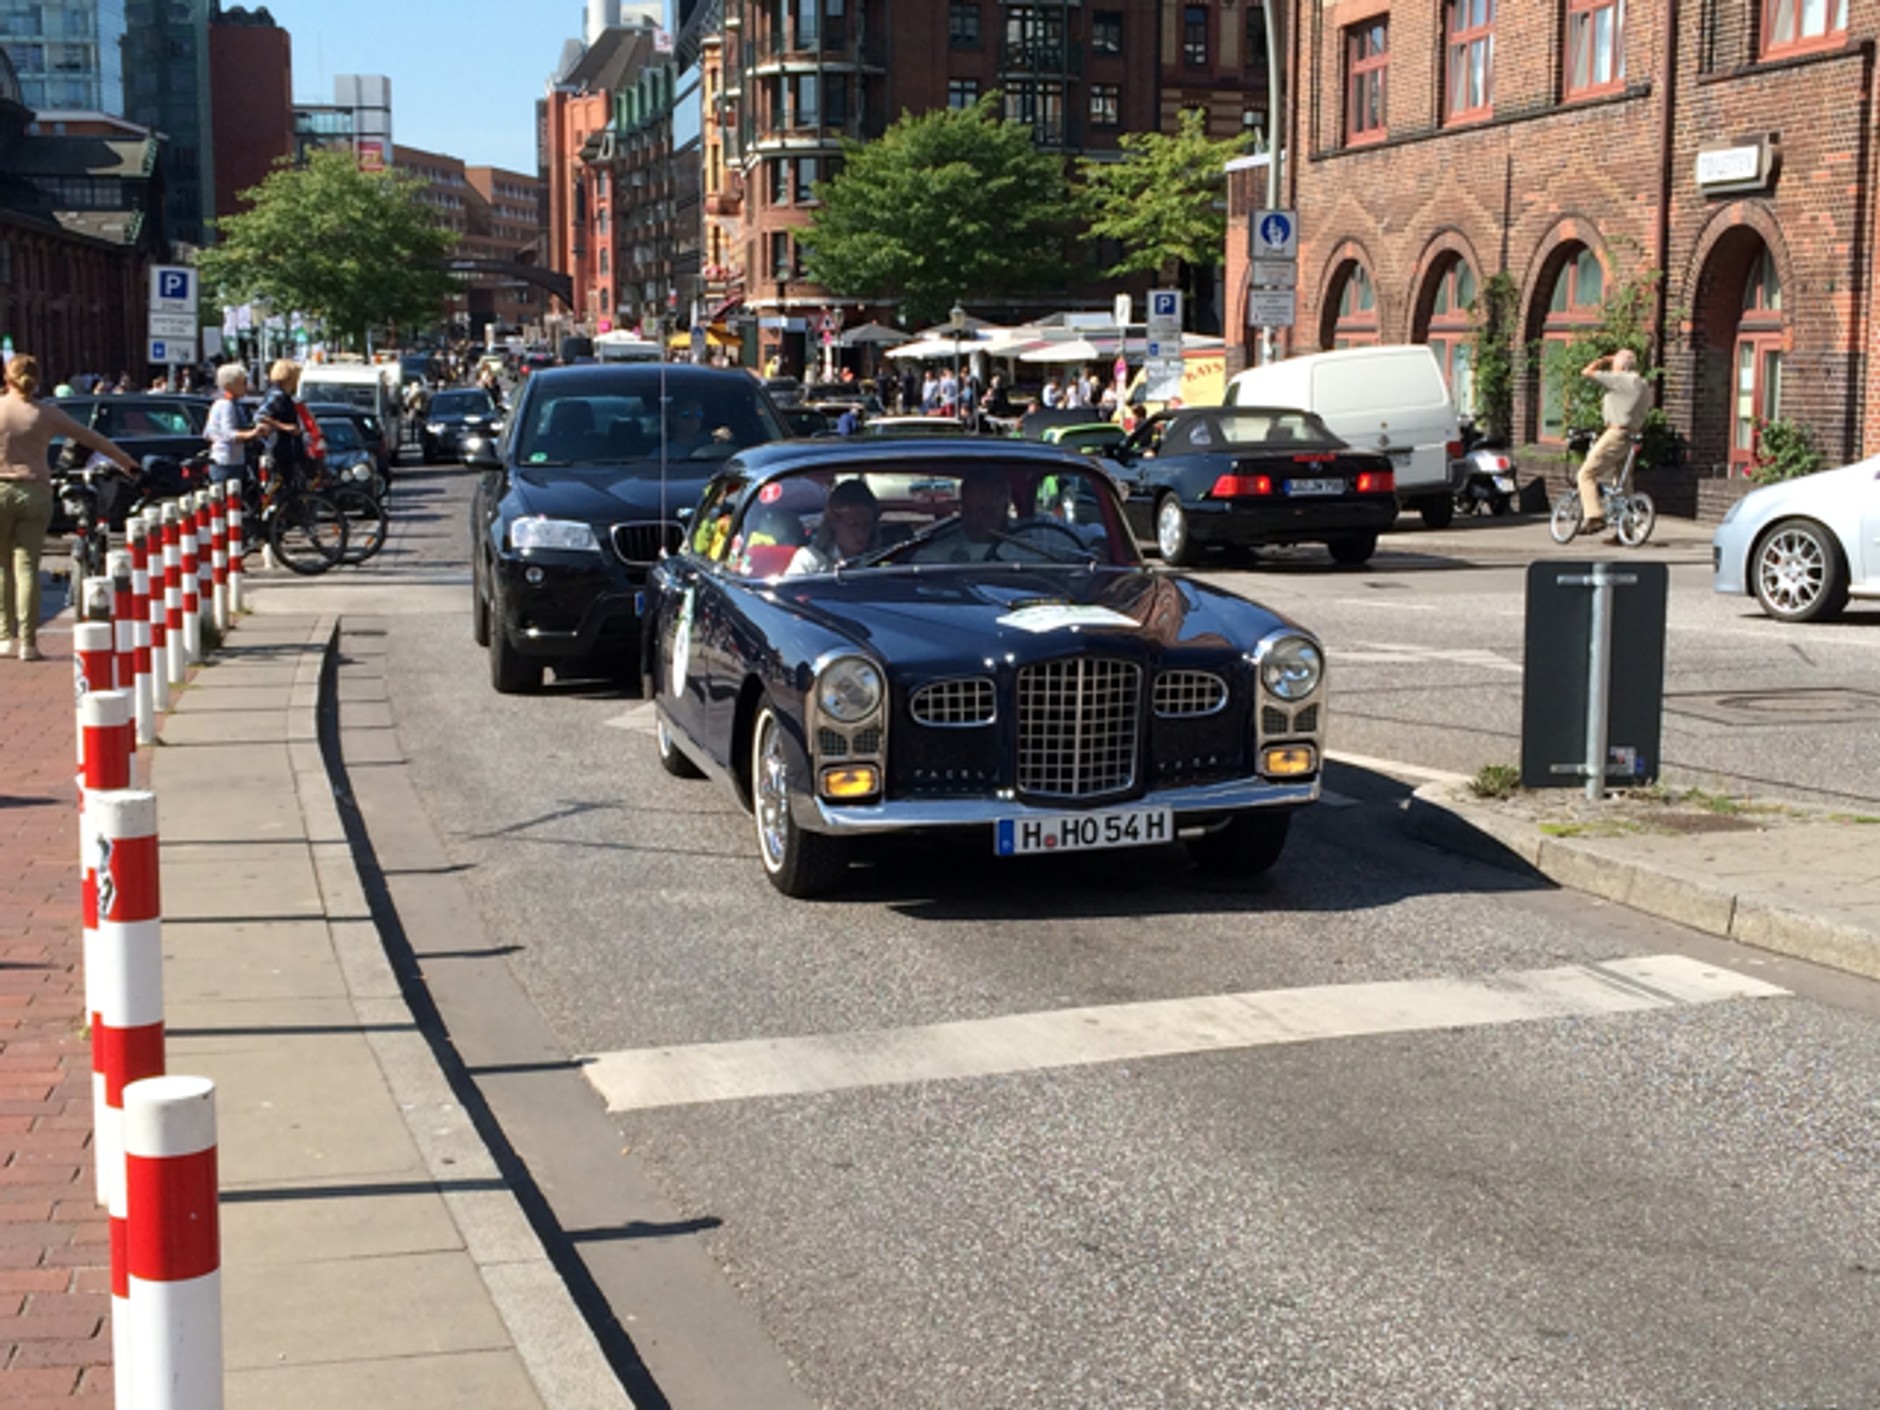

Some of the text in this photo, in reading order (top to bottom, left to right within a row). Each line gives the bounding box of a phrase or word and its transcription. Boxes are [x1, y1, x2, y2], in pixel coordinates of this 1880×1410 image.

[165, 273, 182, 295] P
[1158, 296, 1171, 312] P
[1022, 821, 1042, 849] H
[1061, 816, 1098, 847] HO
